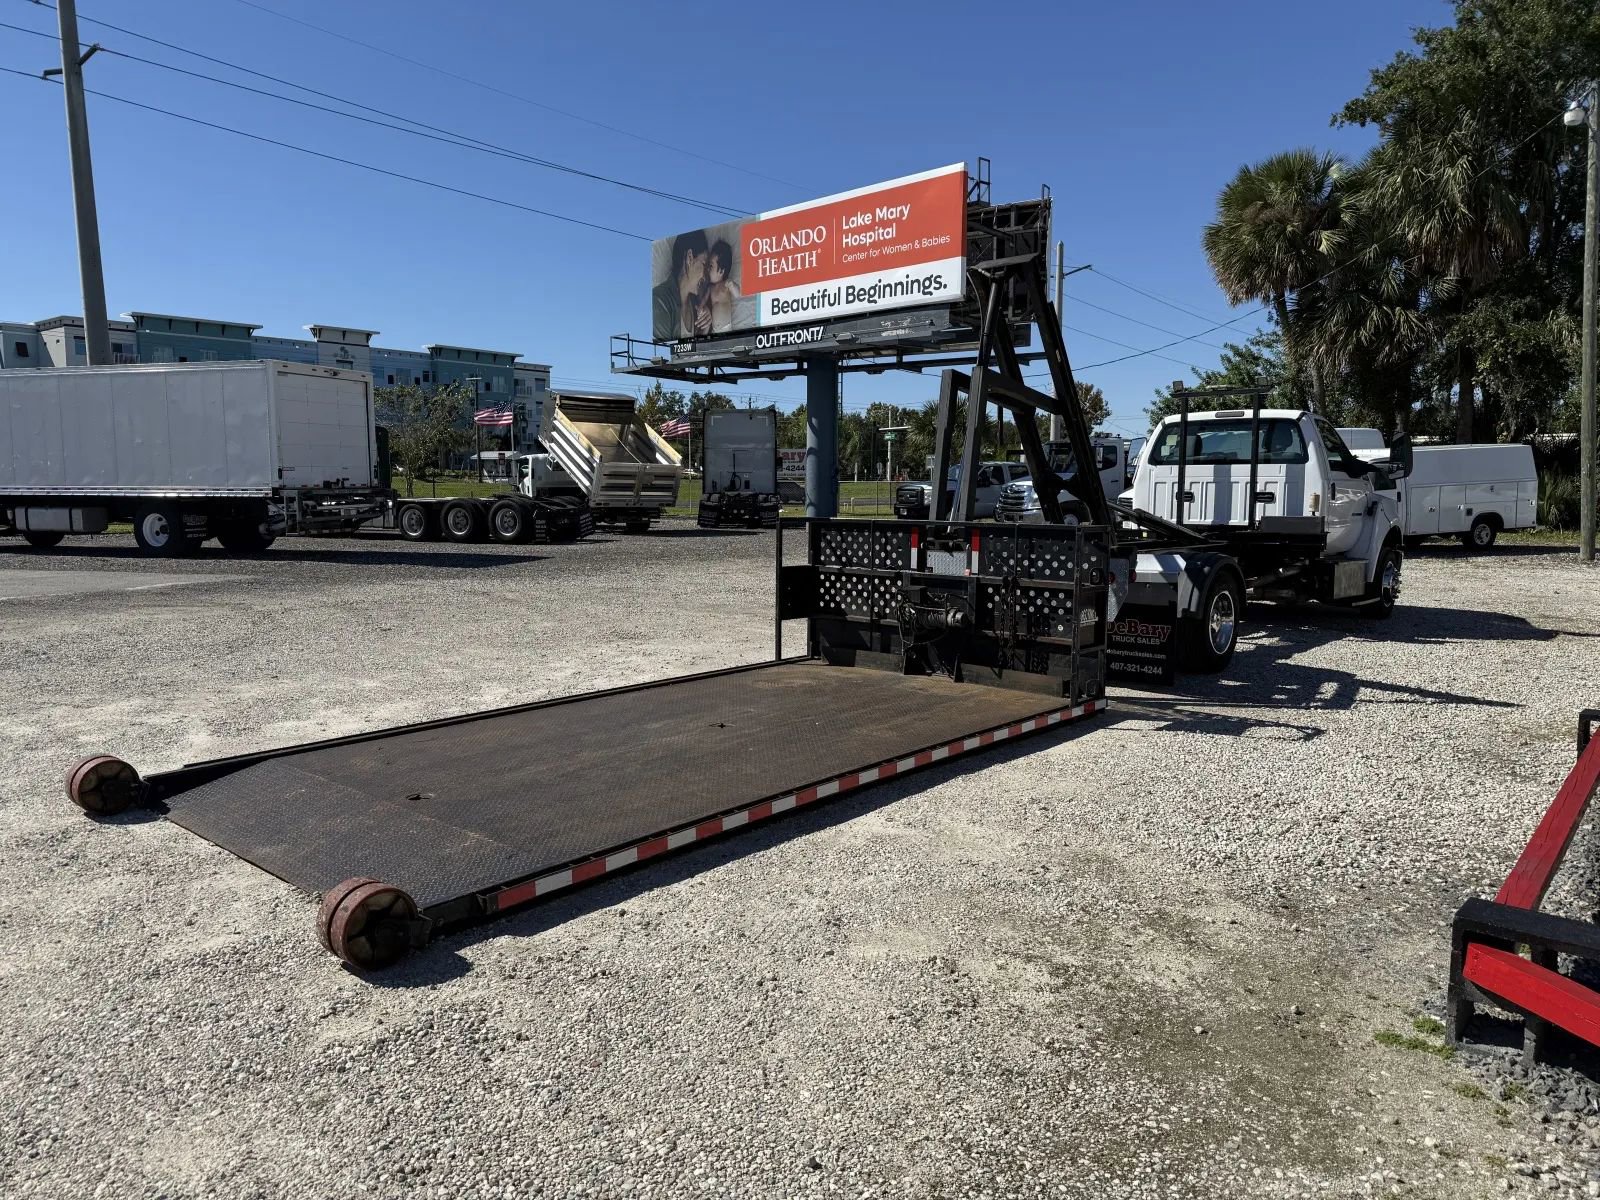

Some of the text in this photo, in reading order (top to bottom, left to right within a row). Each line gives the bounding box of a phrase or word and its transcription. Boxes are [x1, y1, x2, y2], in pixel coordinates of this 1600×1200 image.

[842, 203, 911, 230] Lake Mary
[749, 225, 827, 257] ORLANDO
[842, 222, 896, 249] Hospital
[842, 234, 951, 263] Center for Women & Babies
[757, 250, 817, 278] HEALTH
[771, 273, 948, 316] Beautiful Beginnings.
[1112, 635, 1161, 645] TRUCK SALES
[1110, 662, 1162, 674] 407-321-4244
